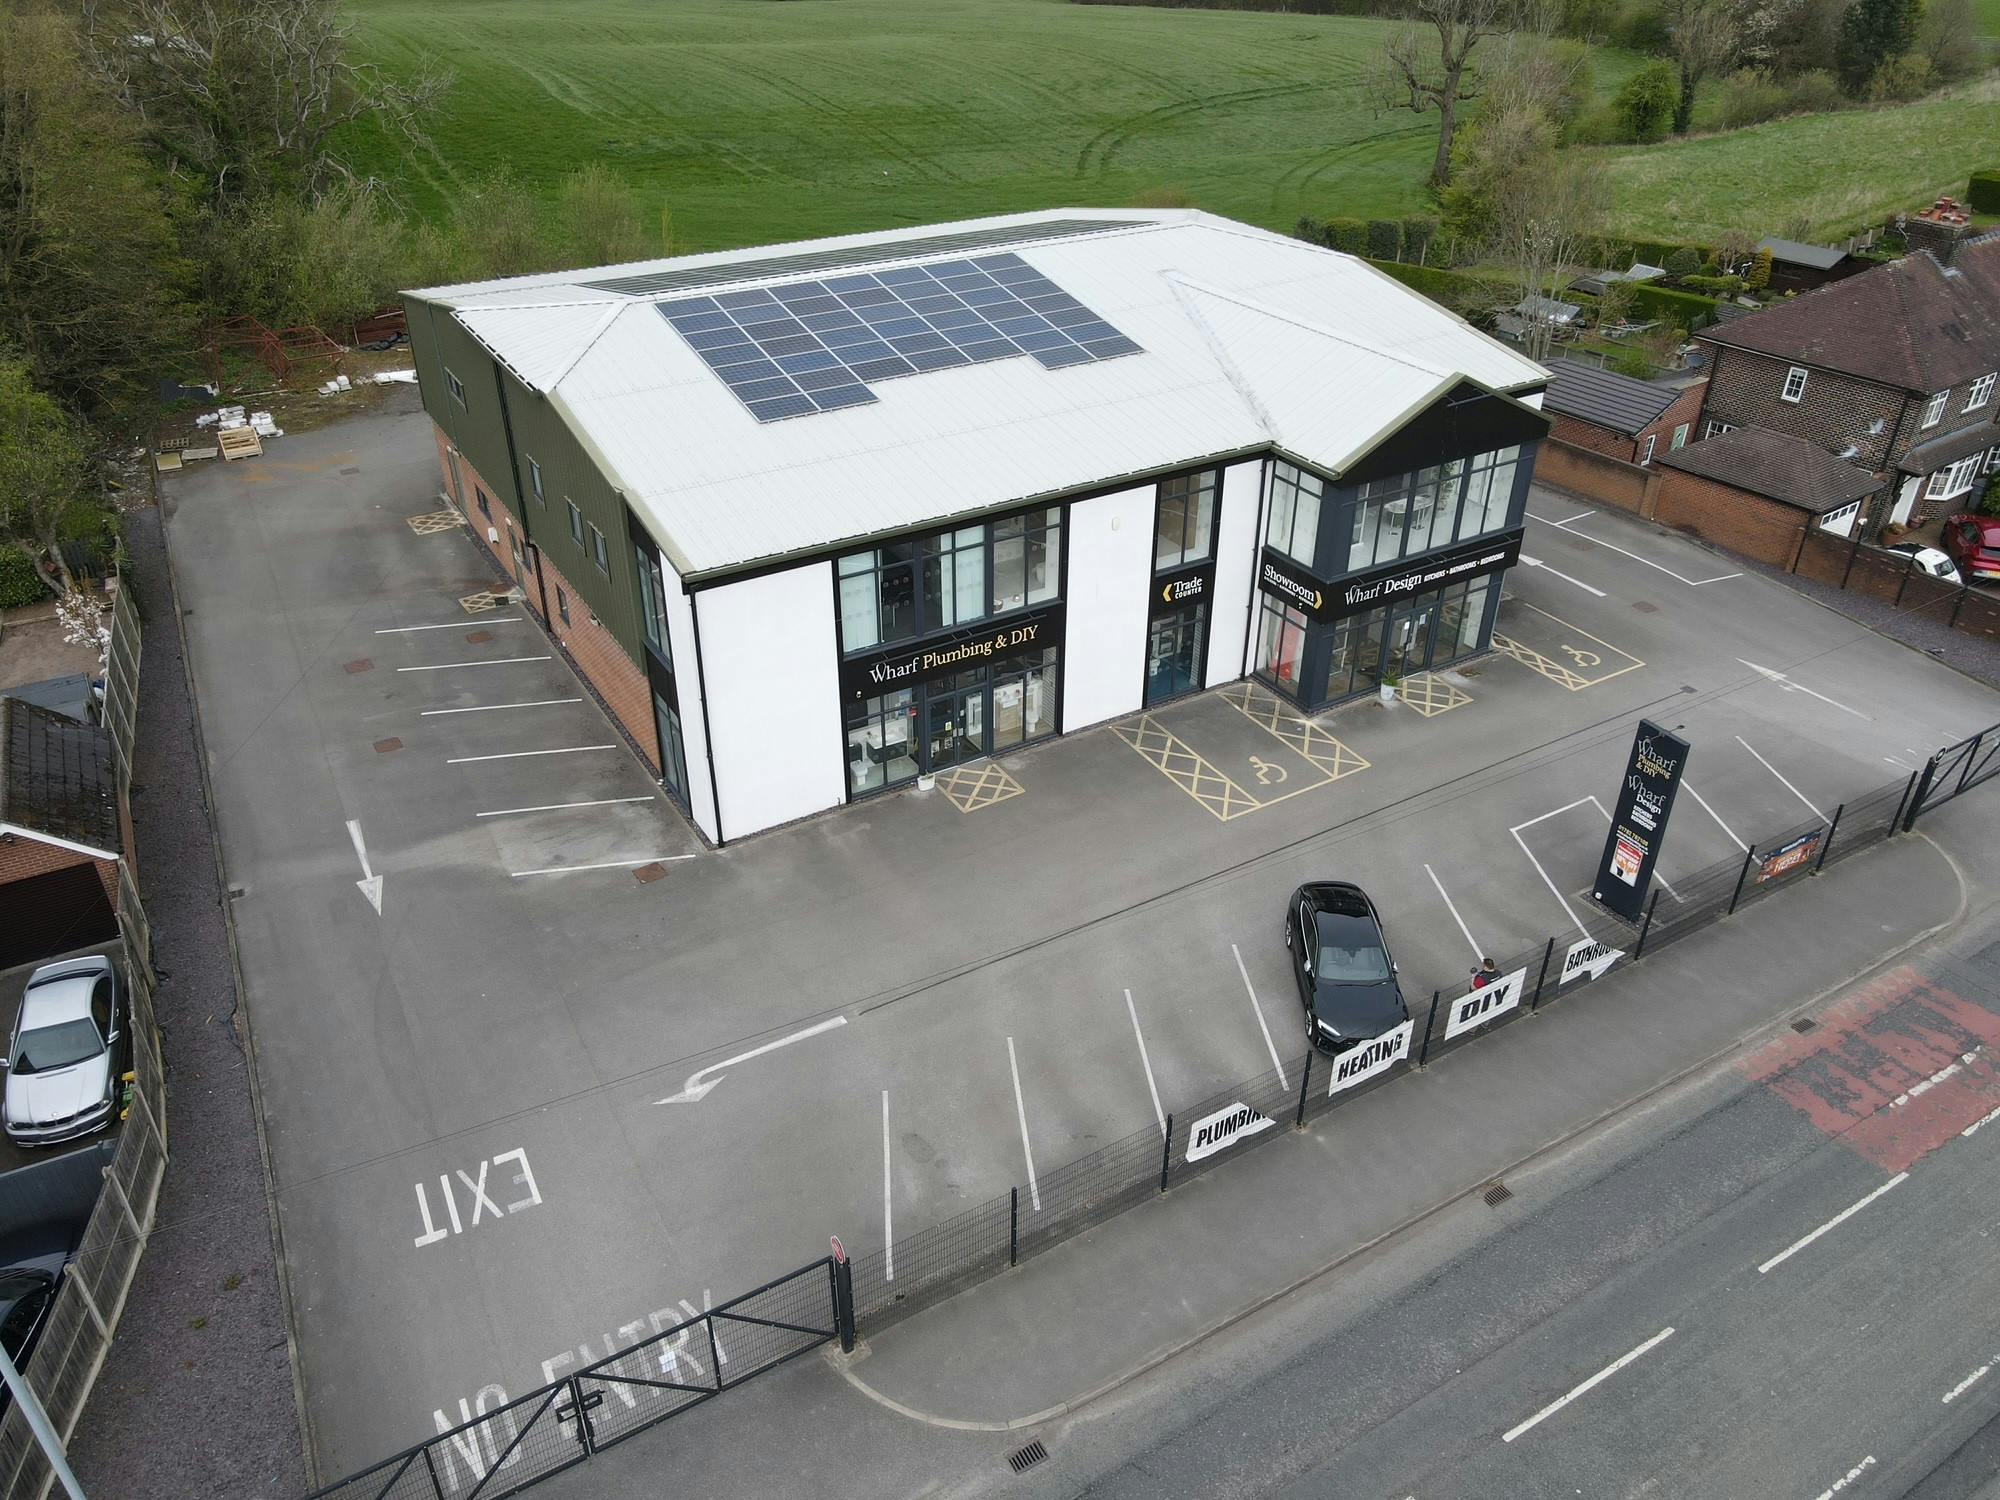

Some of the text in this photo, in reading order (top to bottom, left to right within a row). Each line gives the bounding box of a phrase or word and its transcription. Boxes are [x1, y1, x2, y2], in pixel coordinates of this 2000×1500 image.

[1174, 576, 1203, 593] Trade
[1175, 586, 1202, 600] COUNTER
[1264, 564, 1315, 602] Showroom
[1344, 582, 1382, 606] Wharf
[1383, 574, 1422, 595] Design
[869, 625, 1039, 684] Wharf Plumbing & DIY
[1636, 762, 1658, 779] & DIY
[1637, 738, 1677, 771] Wharf
[1637, 754, 1672, 780] Plumbing
[1628, 775, 1666, 805] Wharf
[1636, 795, 1661, 814] Design
[1459, 982, 1511, 1024] DIY
[1337, 1033, 1404, 1083] HEATING
[1196, 1107, 1267, 1148] PLUMBIN
[413, 1146, 544, 1248] EXIT
[431, 1287, 729, 1493] NO ENTRY
